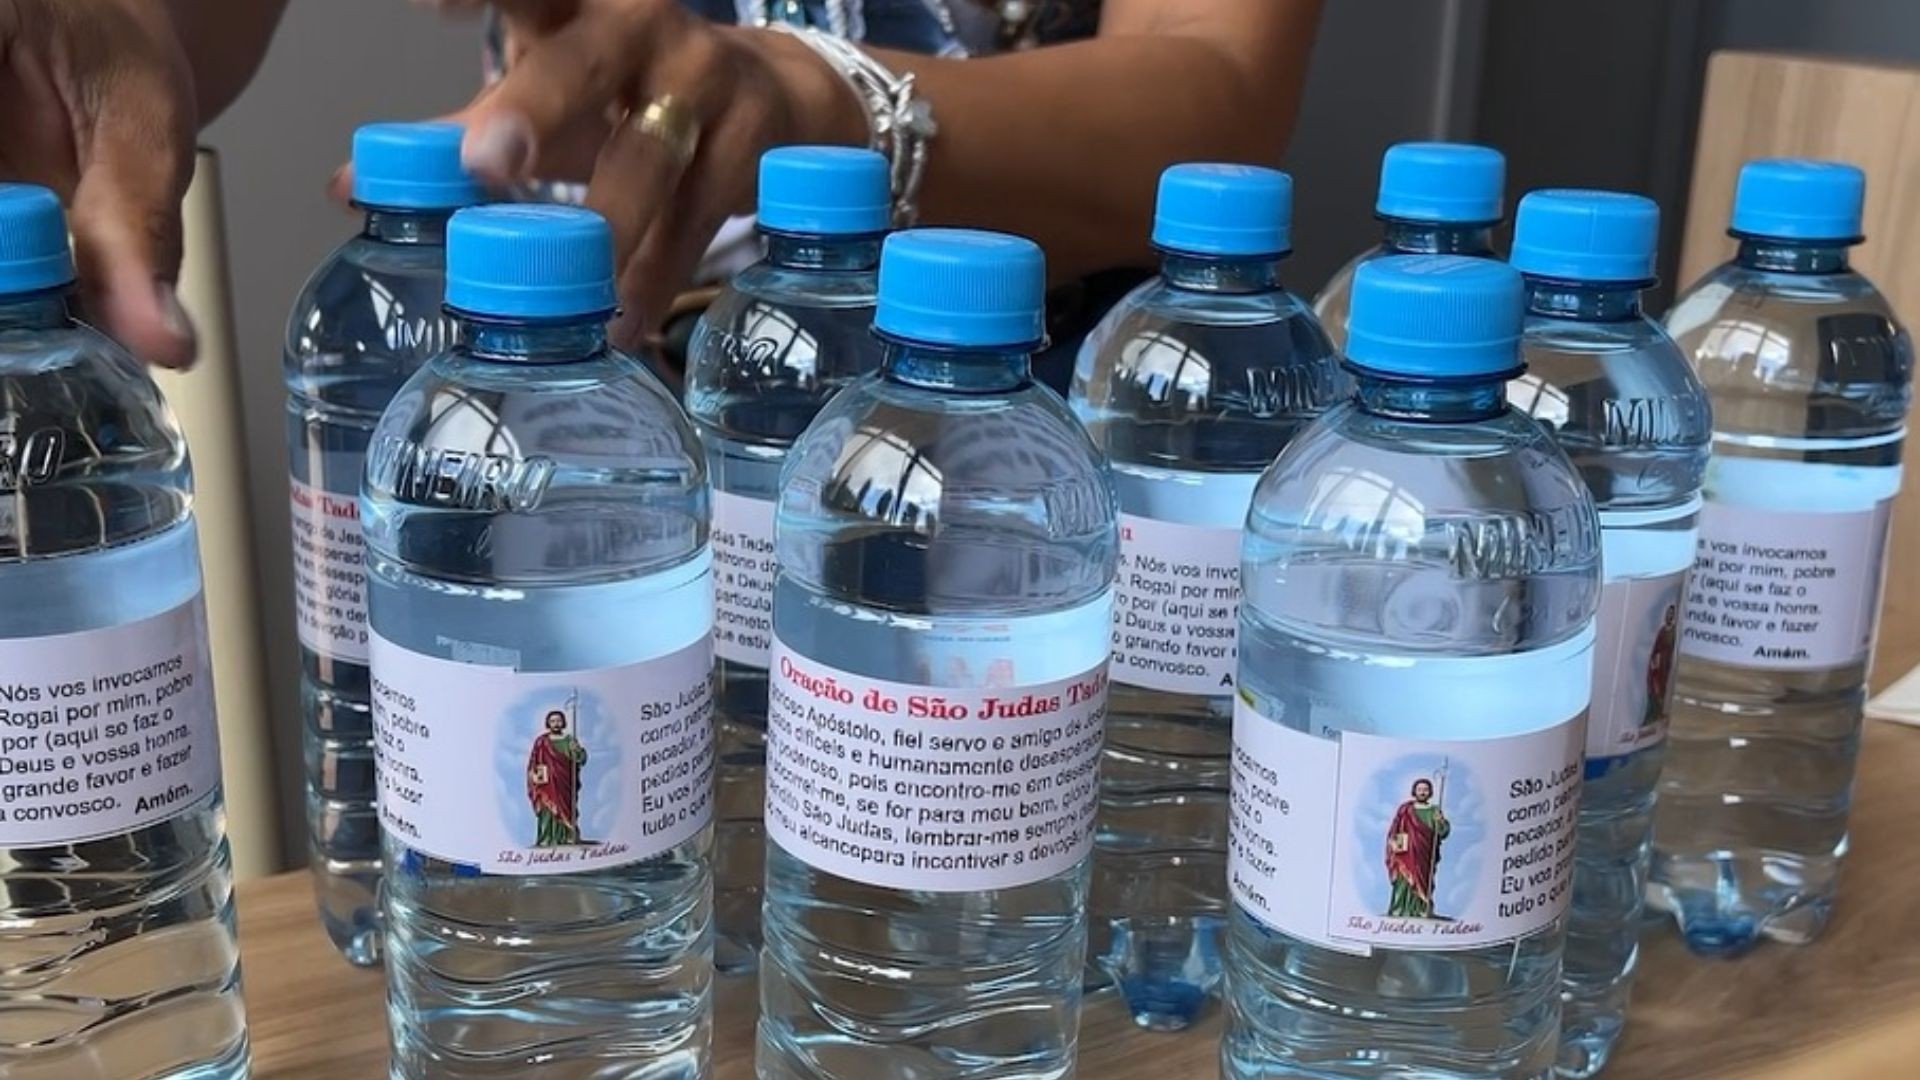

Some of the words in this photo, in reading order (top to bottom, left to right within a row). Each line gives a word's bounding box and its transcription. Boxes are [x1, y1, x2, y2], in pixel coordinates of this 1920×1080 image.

[322, 495, 361, 521] Tad
[1710, 540, 1738, 556] vos
[1741, 543, 1828, 561] invocamos
[1134, 554, 1168, 575] Nós
[1172, 564, 1202, 580] vos
[1718, 559, 1746, 574] por
[1792, 567, 1837, 581] pobre
[1129, 573, 1177, 596] Rogai
[1180, 585, 1209, 602] por
[1700, 575, 1741, 593] (aqui
[1743, 582, 1763, 595] se
[1768, 582, 1791, 597] faz
[1796, 585, 1807, 597] o
[1131, 596, 1157, 613] por
[1707, 595, 1719, 607] e
[1722, 599, 1769, 614] vossa
[1125, 612, 1168, 633] Deus
[1170, 621, 1184, 636] e
[1720, 613, 1761, 631] favor
[1765, 620, 1777, 633] e
[1780, 618, 1820, 633] fazer
[1124, 634, 1182, 657] grande
[1185, 640, 1227, 659] favor
[48, 681, 86, 699] vos
[92, 654, 183, 693] invocamos
[1129, 653, 1212, 678] convosco.
[779, 654, 855, 705] Oração
[863, 687, 900, 714] de
[908, 694, 969, 721] São
[977, 692, 1062, 722] Judas
[1218, 672, 1234, 688] A
[0, 705, 58, 729] Rogai
[66, 703, 101, 727] por
[156, 673, 194, 704] pobre
[640, 702, 673, 722] São
[2, 735, 39, 754] por
[46, 726, 98, 752] (aqui
[105, 721, 128, 739] se
[134, 712, 159, 732] faz
[163, 706, 174, 721] o
[640, 719, 683, 745] como
[806, 706, 887, 747] Apóstolo,
[893, 728, 923, 750] fiel
[928, 736, 988, 752] servo
[991, 736, 1005, 752] e
[1010, 727, 1062, 750] amigo
[0, 757, 56, 776] Deus
[62, 755, 76, 770] e
[82, 742, 141, 766] vossa
[851, 748, 863, 764] e
[868, 749, 1015, 777] humanamente
[2, 776, 80, 803] grande
[86, 768, 137, 790] favor
[141, 763, 153, 778] e
[848, 773, 888, 794] pois
[894, 781, 1022, 801] encontro-me
[1025, 776, 1052, 794] em
[1509, 777, 1544, 800] São
[13, 796, 121, 823] convosco.
[135, 783, 194, 816] Amém.
[641, 795, 665, 815] Eu
[856, 798, 880, 816] se
[885, 799, 914, 821] for
[918, 807, 966, 827] para
[971, 807, 1014, 825] meu
[1506, 798, 1552, 824] como
[679, 806, 688, 821] o
[803, 799, 834, 827] São
[836, 813, 899, 845] Judas,
[905, 827, 1021, 847] lembrar-me
[911, 850, 1009, 871] incentivar
[1012, 849, 1025, 865] a
[1500, 875, 1525, 895] Eu
[1498, 896, 1535, 918] tudo
[1537, 893, 1547, 907] o
